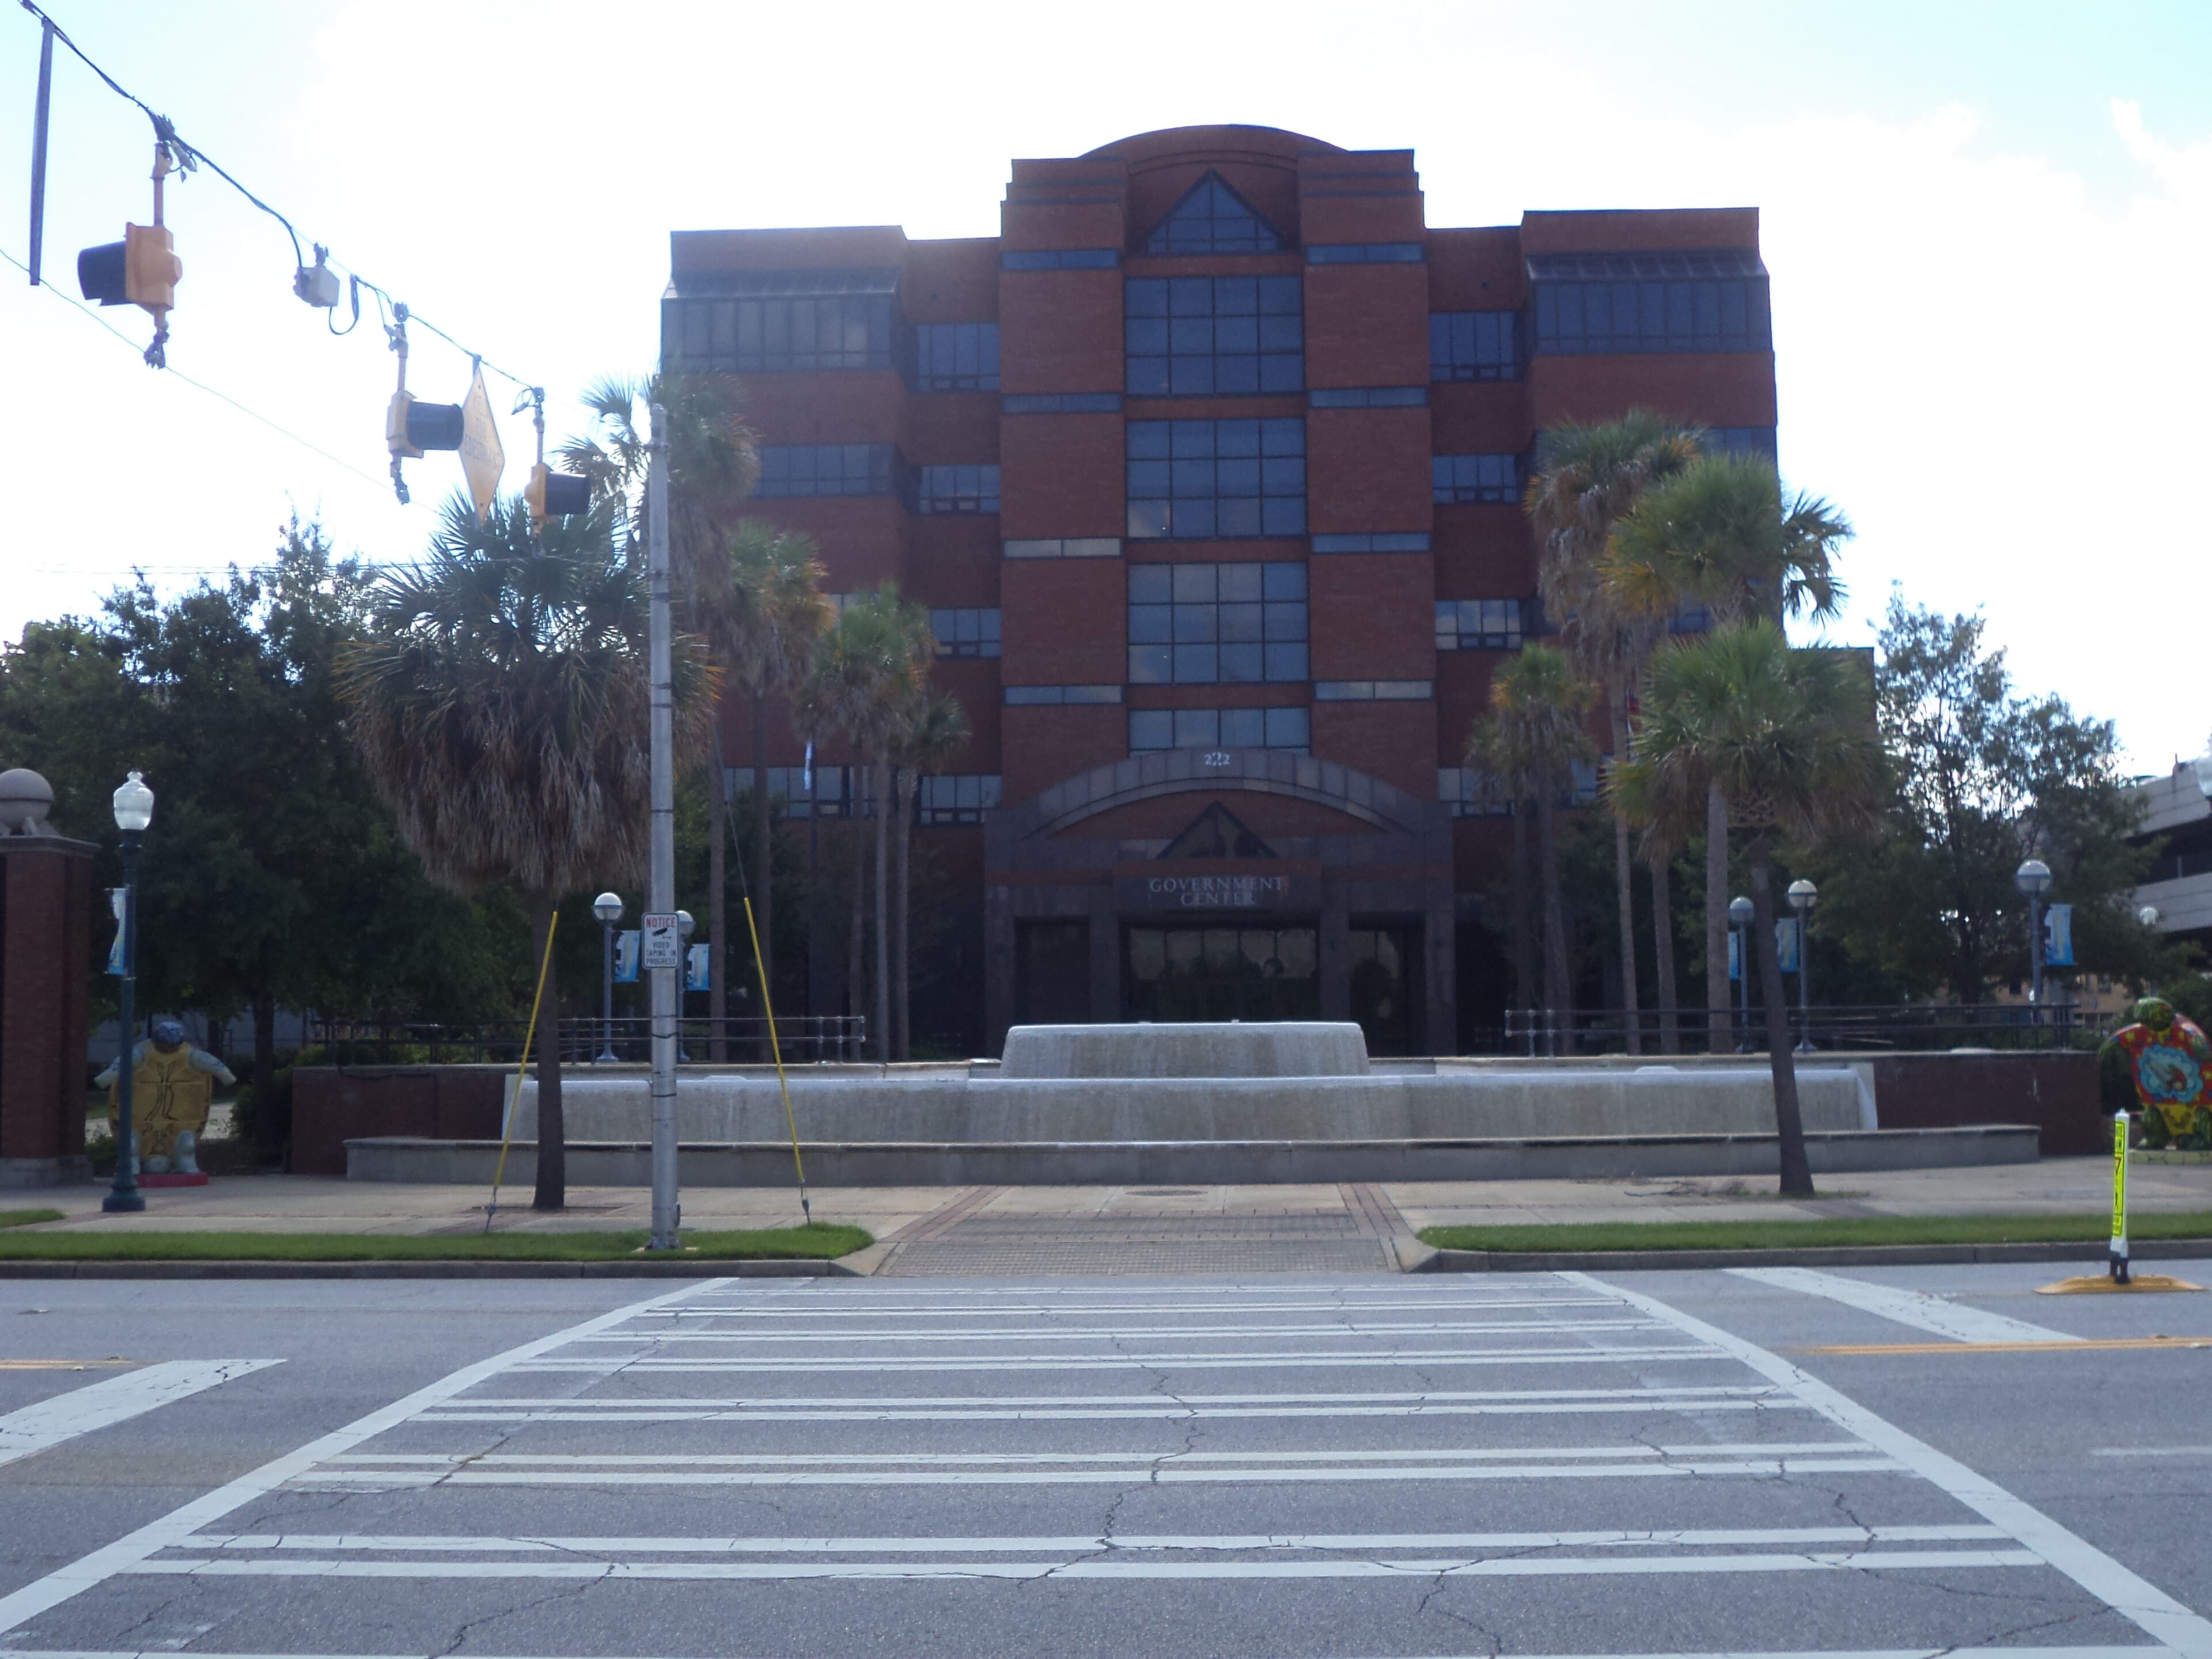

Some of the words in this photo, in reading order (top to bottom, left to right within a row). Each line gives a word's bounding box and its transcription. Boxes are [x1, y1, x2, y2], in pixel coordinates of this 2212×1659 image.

[1205, 751, 1230, 766] 222
[1150, 877, 1283, 892] GOVERNMENT
[1180, 892, 1256, 907] CENTER
[646, 917, 676, 928] NOTICE
